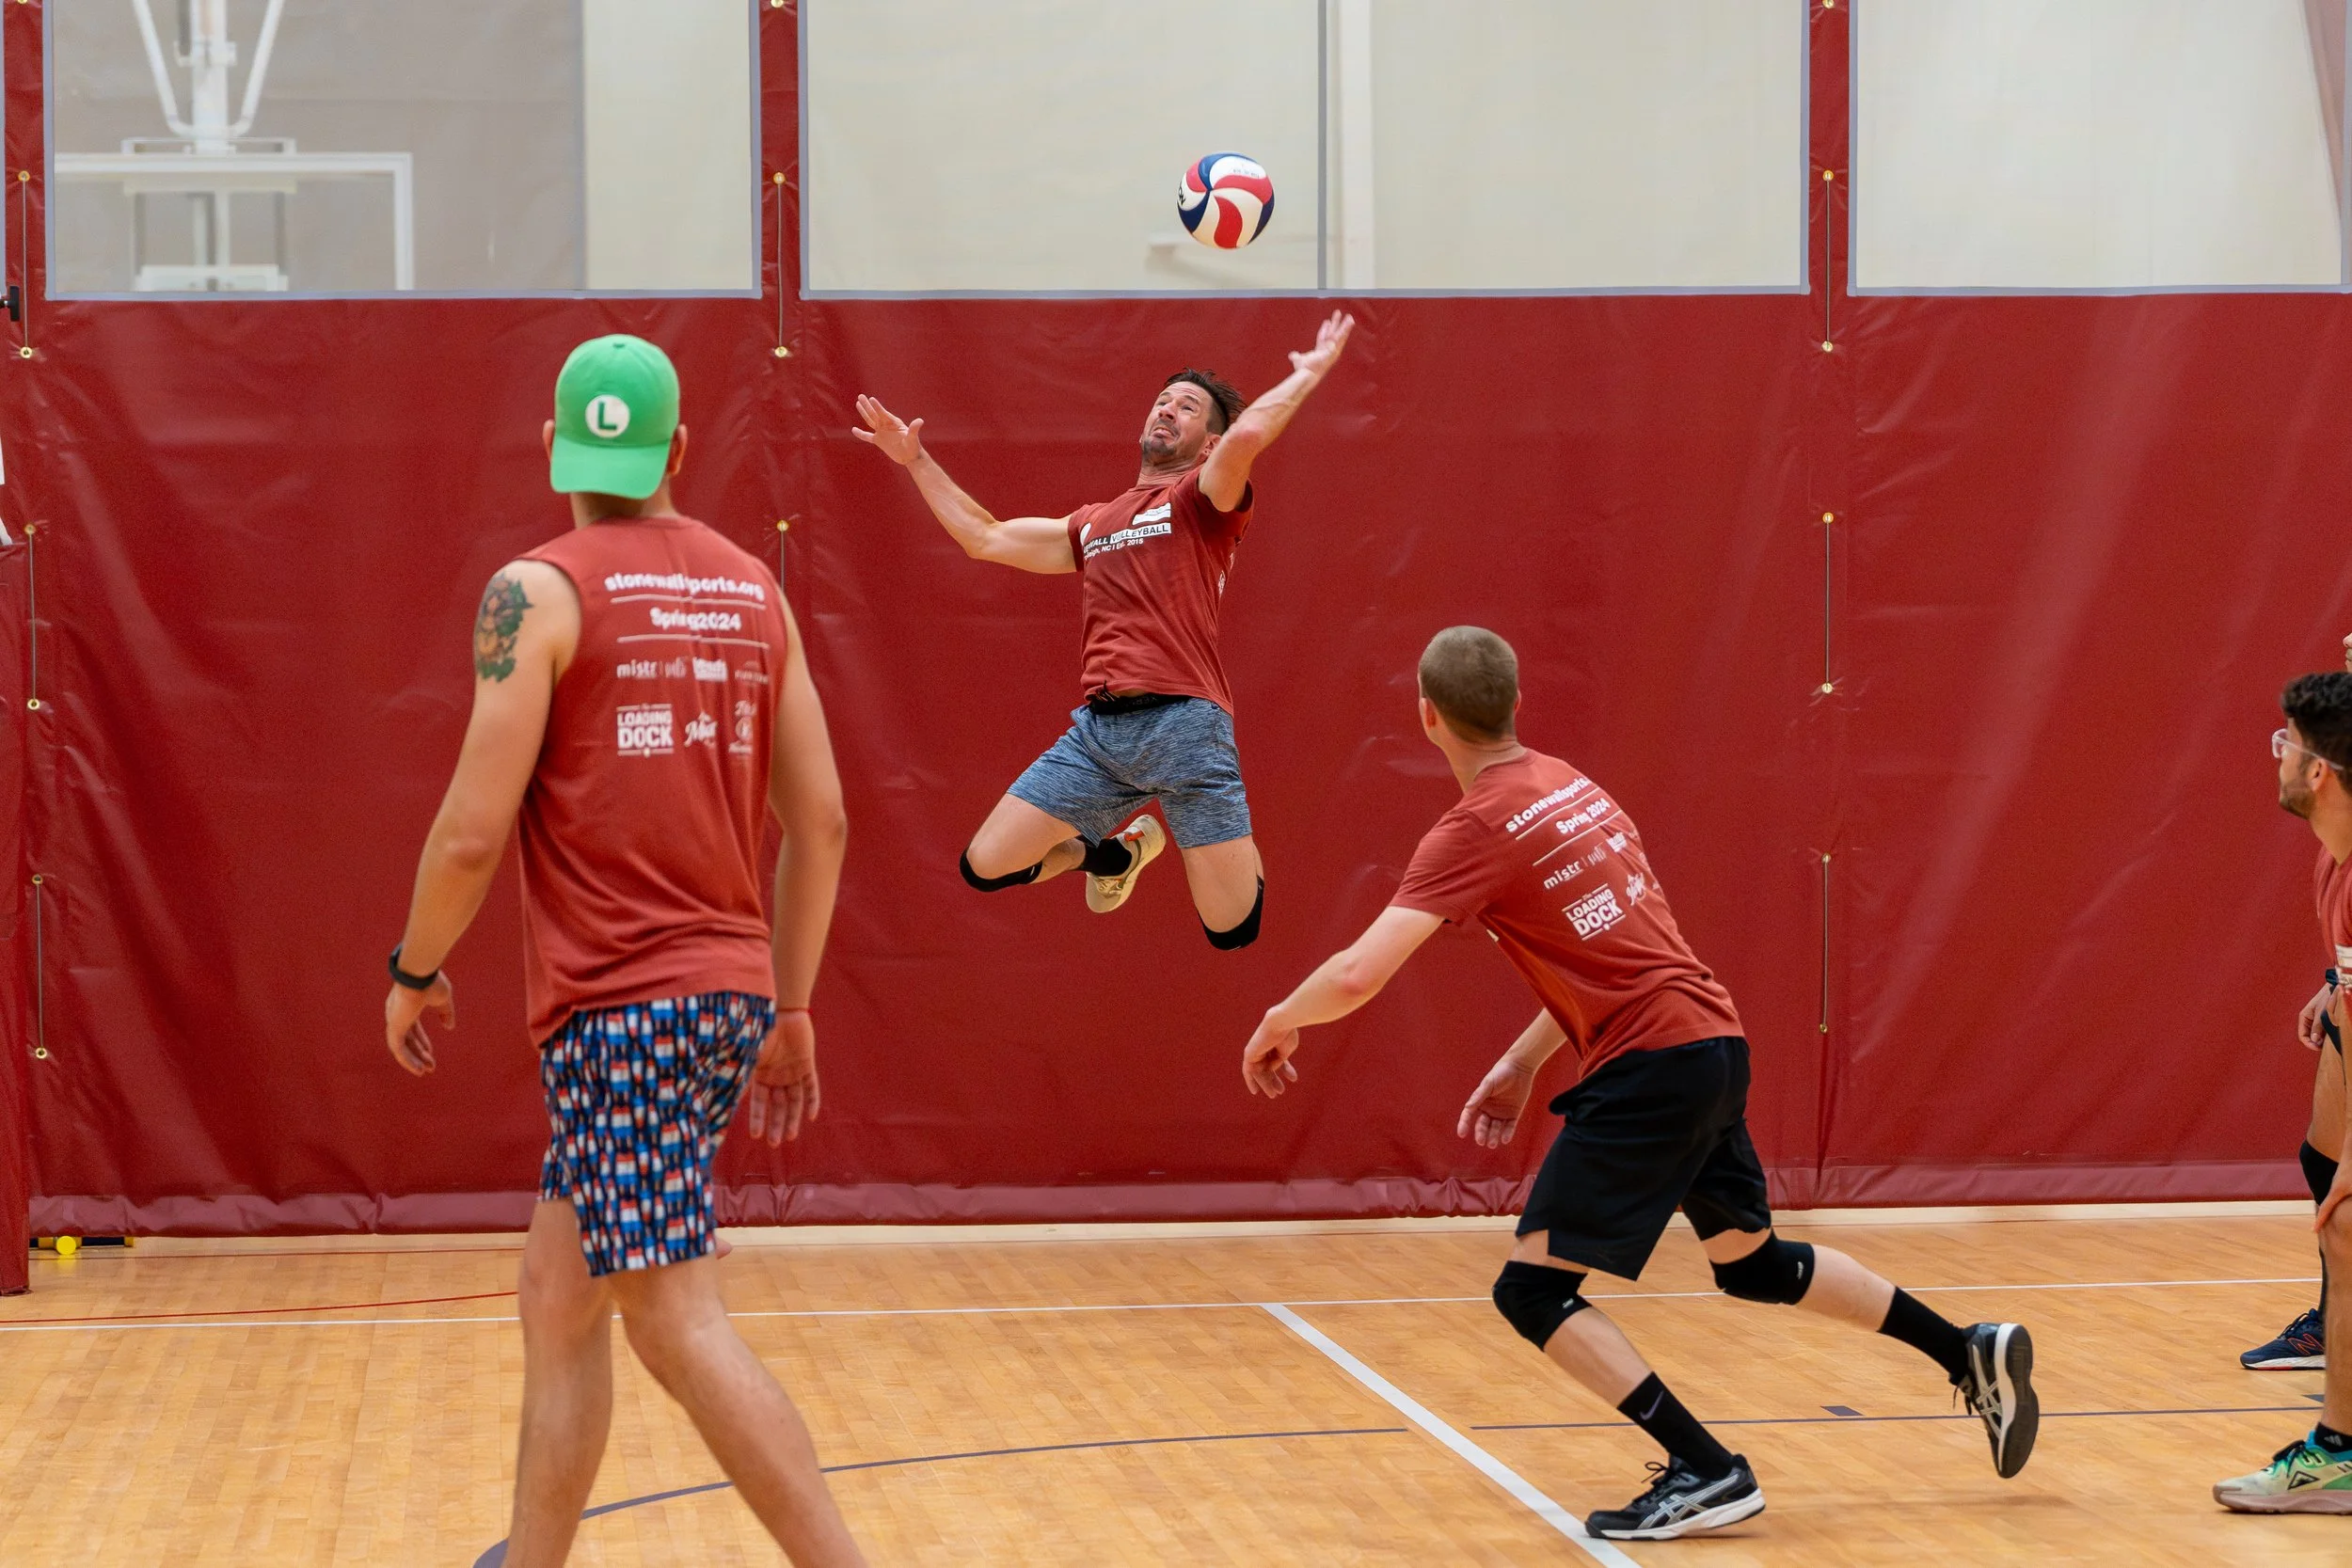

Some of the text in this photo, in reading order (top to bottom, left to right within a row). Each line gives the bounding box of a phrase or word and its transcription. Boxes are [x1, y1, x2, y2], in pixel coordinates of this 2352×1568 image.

[597, 402, 617, 430] L
[1111, 525, 1169, 541] VOLLEYBALL
[617, 659, 657, 678] mistr
[617, 711, 673, 726] LOADING
[618, 726, 674, 749] DOCK
[1555, 797, 1612, 834] Spring 2024
[1544, 861, 1581, 889] mistr
[1565, 889, 1614, 922] LOADING
[1573, 899, 1623, 936] DOCK
